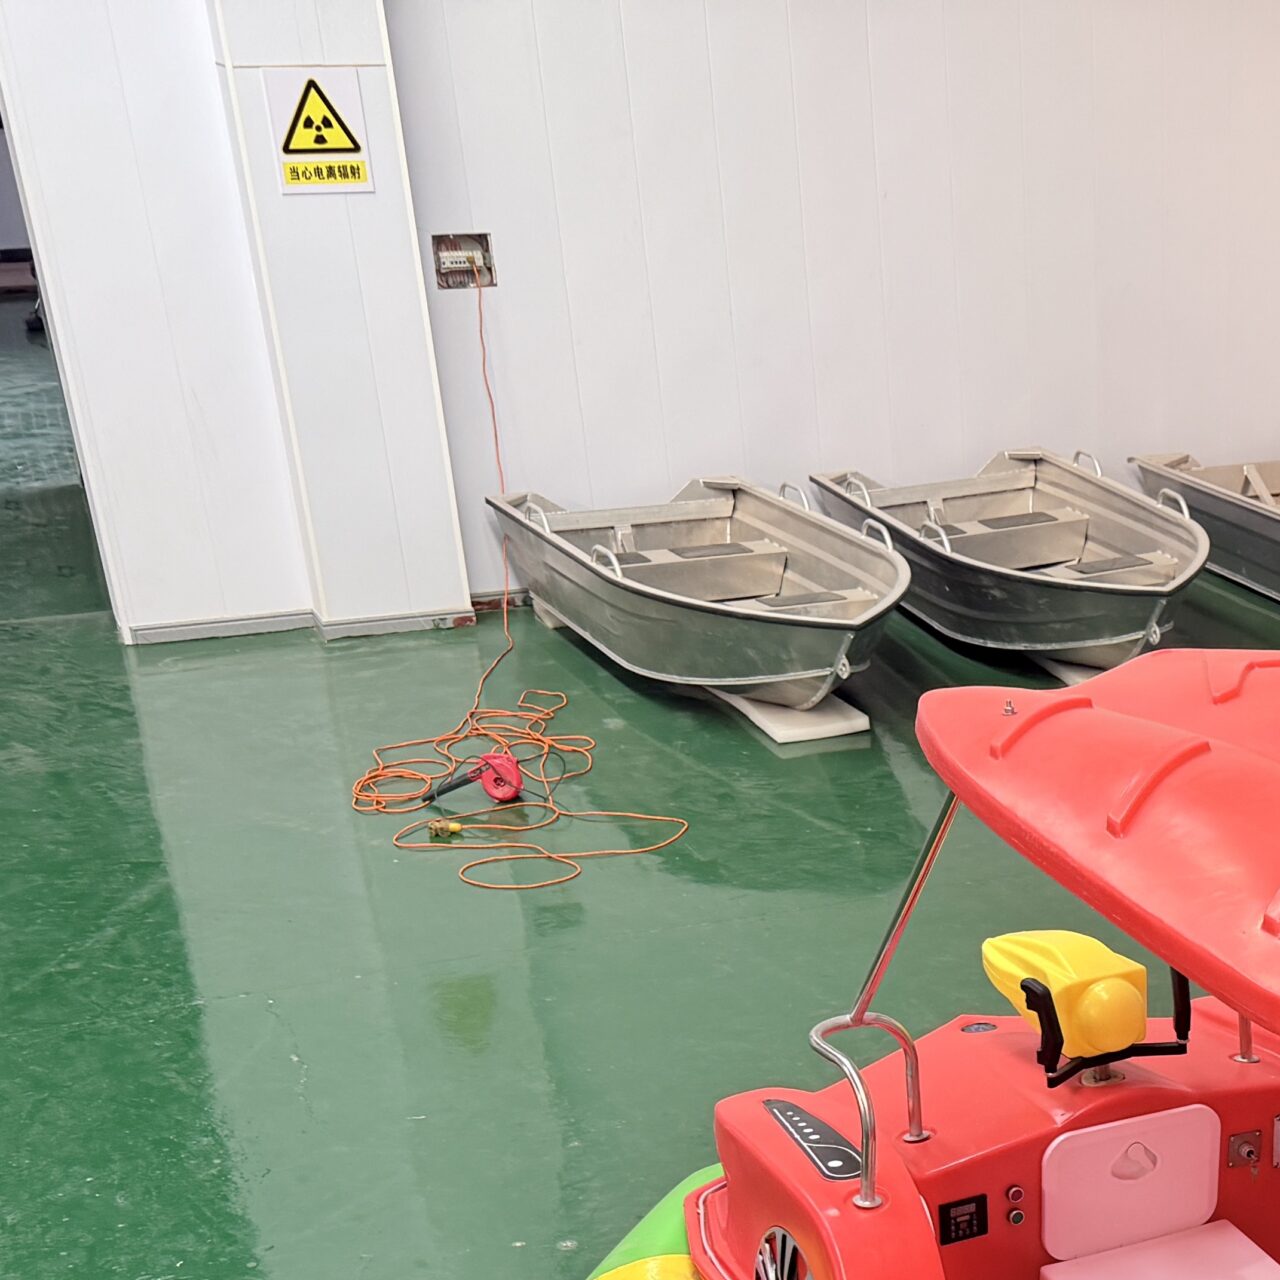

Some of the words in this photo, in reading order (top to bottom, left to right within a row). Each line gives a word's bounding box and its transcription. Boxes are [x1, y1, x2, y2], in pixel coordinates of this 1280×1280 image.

[289, 164, 361, 181] 当心电离辐射
